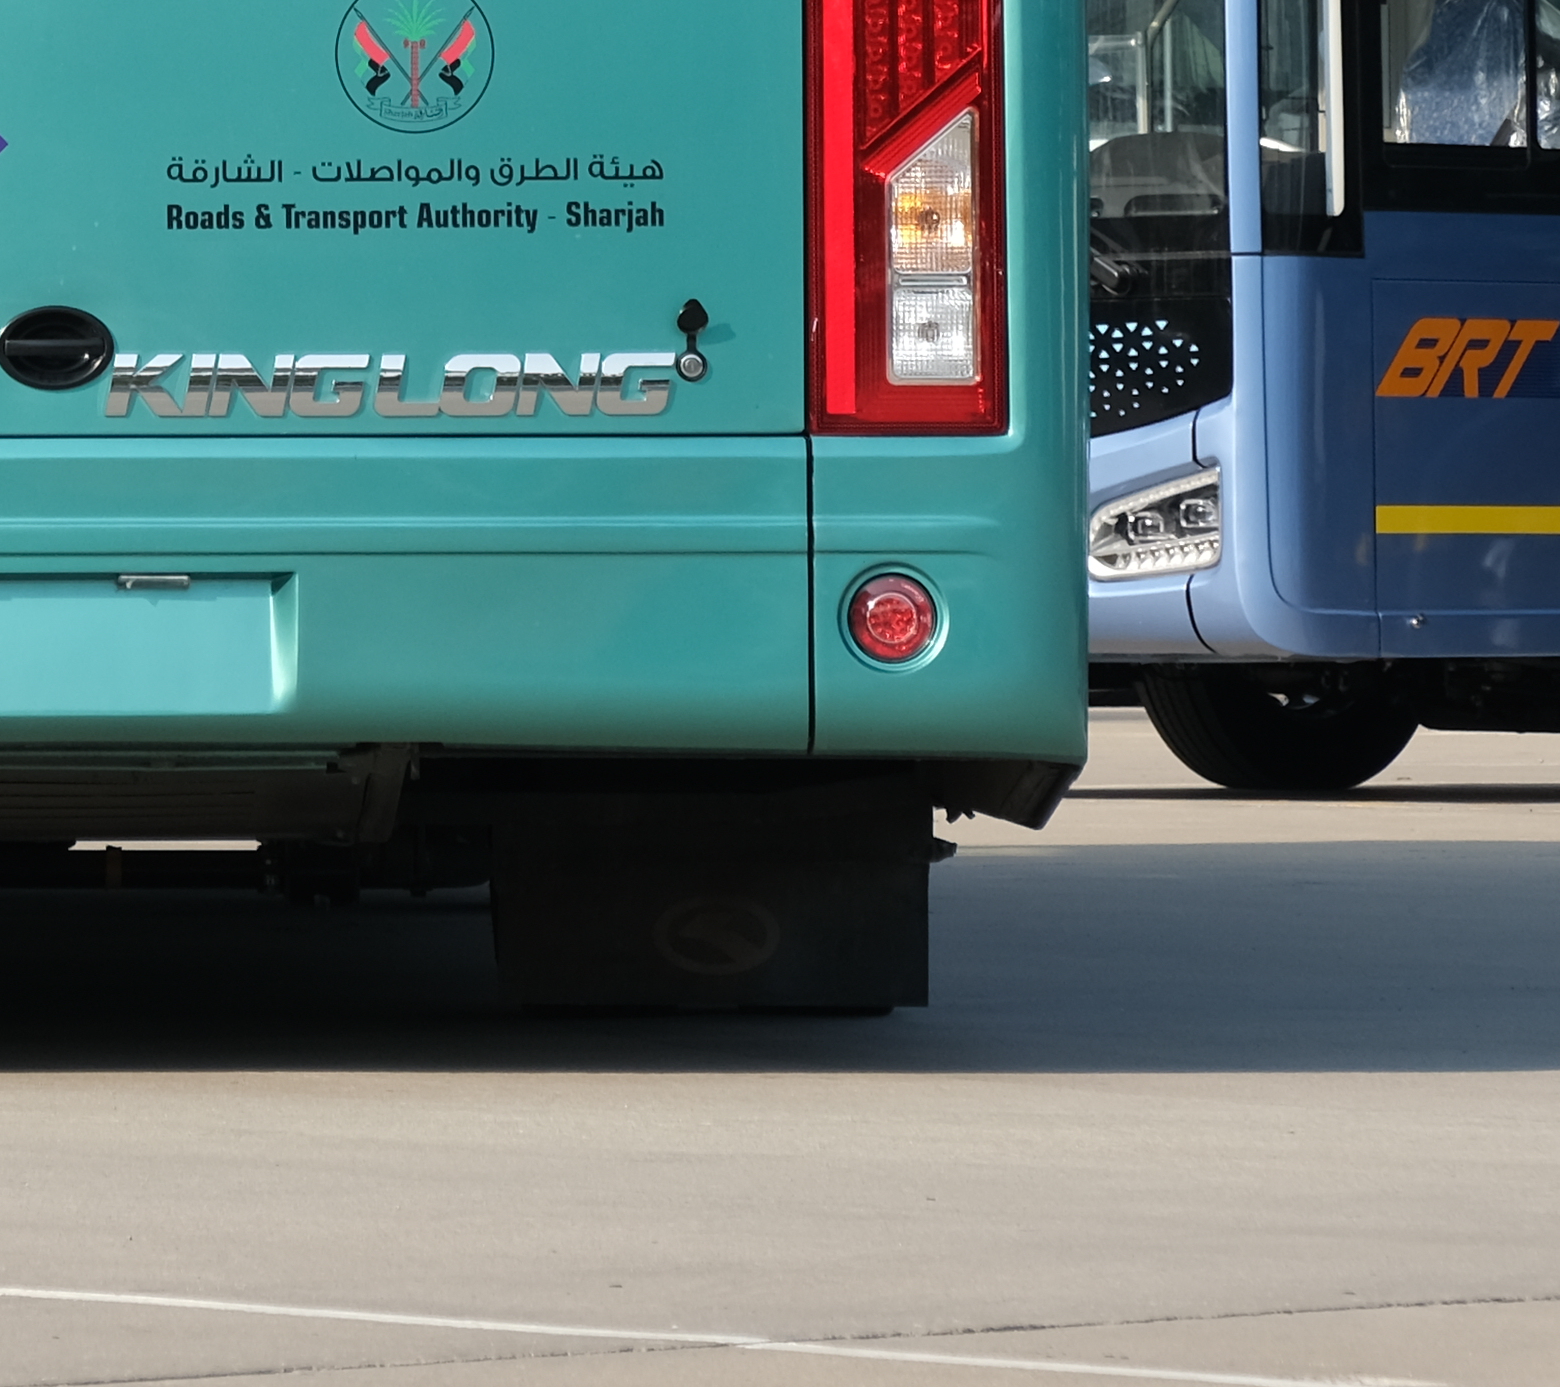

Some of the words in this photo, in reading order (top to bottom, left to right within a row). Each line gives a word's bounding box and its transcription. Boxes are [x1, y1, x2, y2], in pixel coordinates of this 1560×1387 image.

[166, 154, 283, 188] الشارقة
[312, 157, 481, 188] والمواصلات
[489, 157, 579, 187] الطرق
[587, 153, 665, 188] هيئة
[166, 203, 245, 230] Roads
[254, 203, 273, 230] &
[282, 203, 408, 235] Transport
[417, 202, 538, 234] Authority
[566, 201, 665, 233] Sharjah
